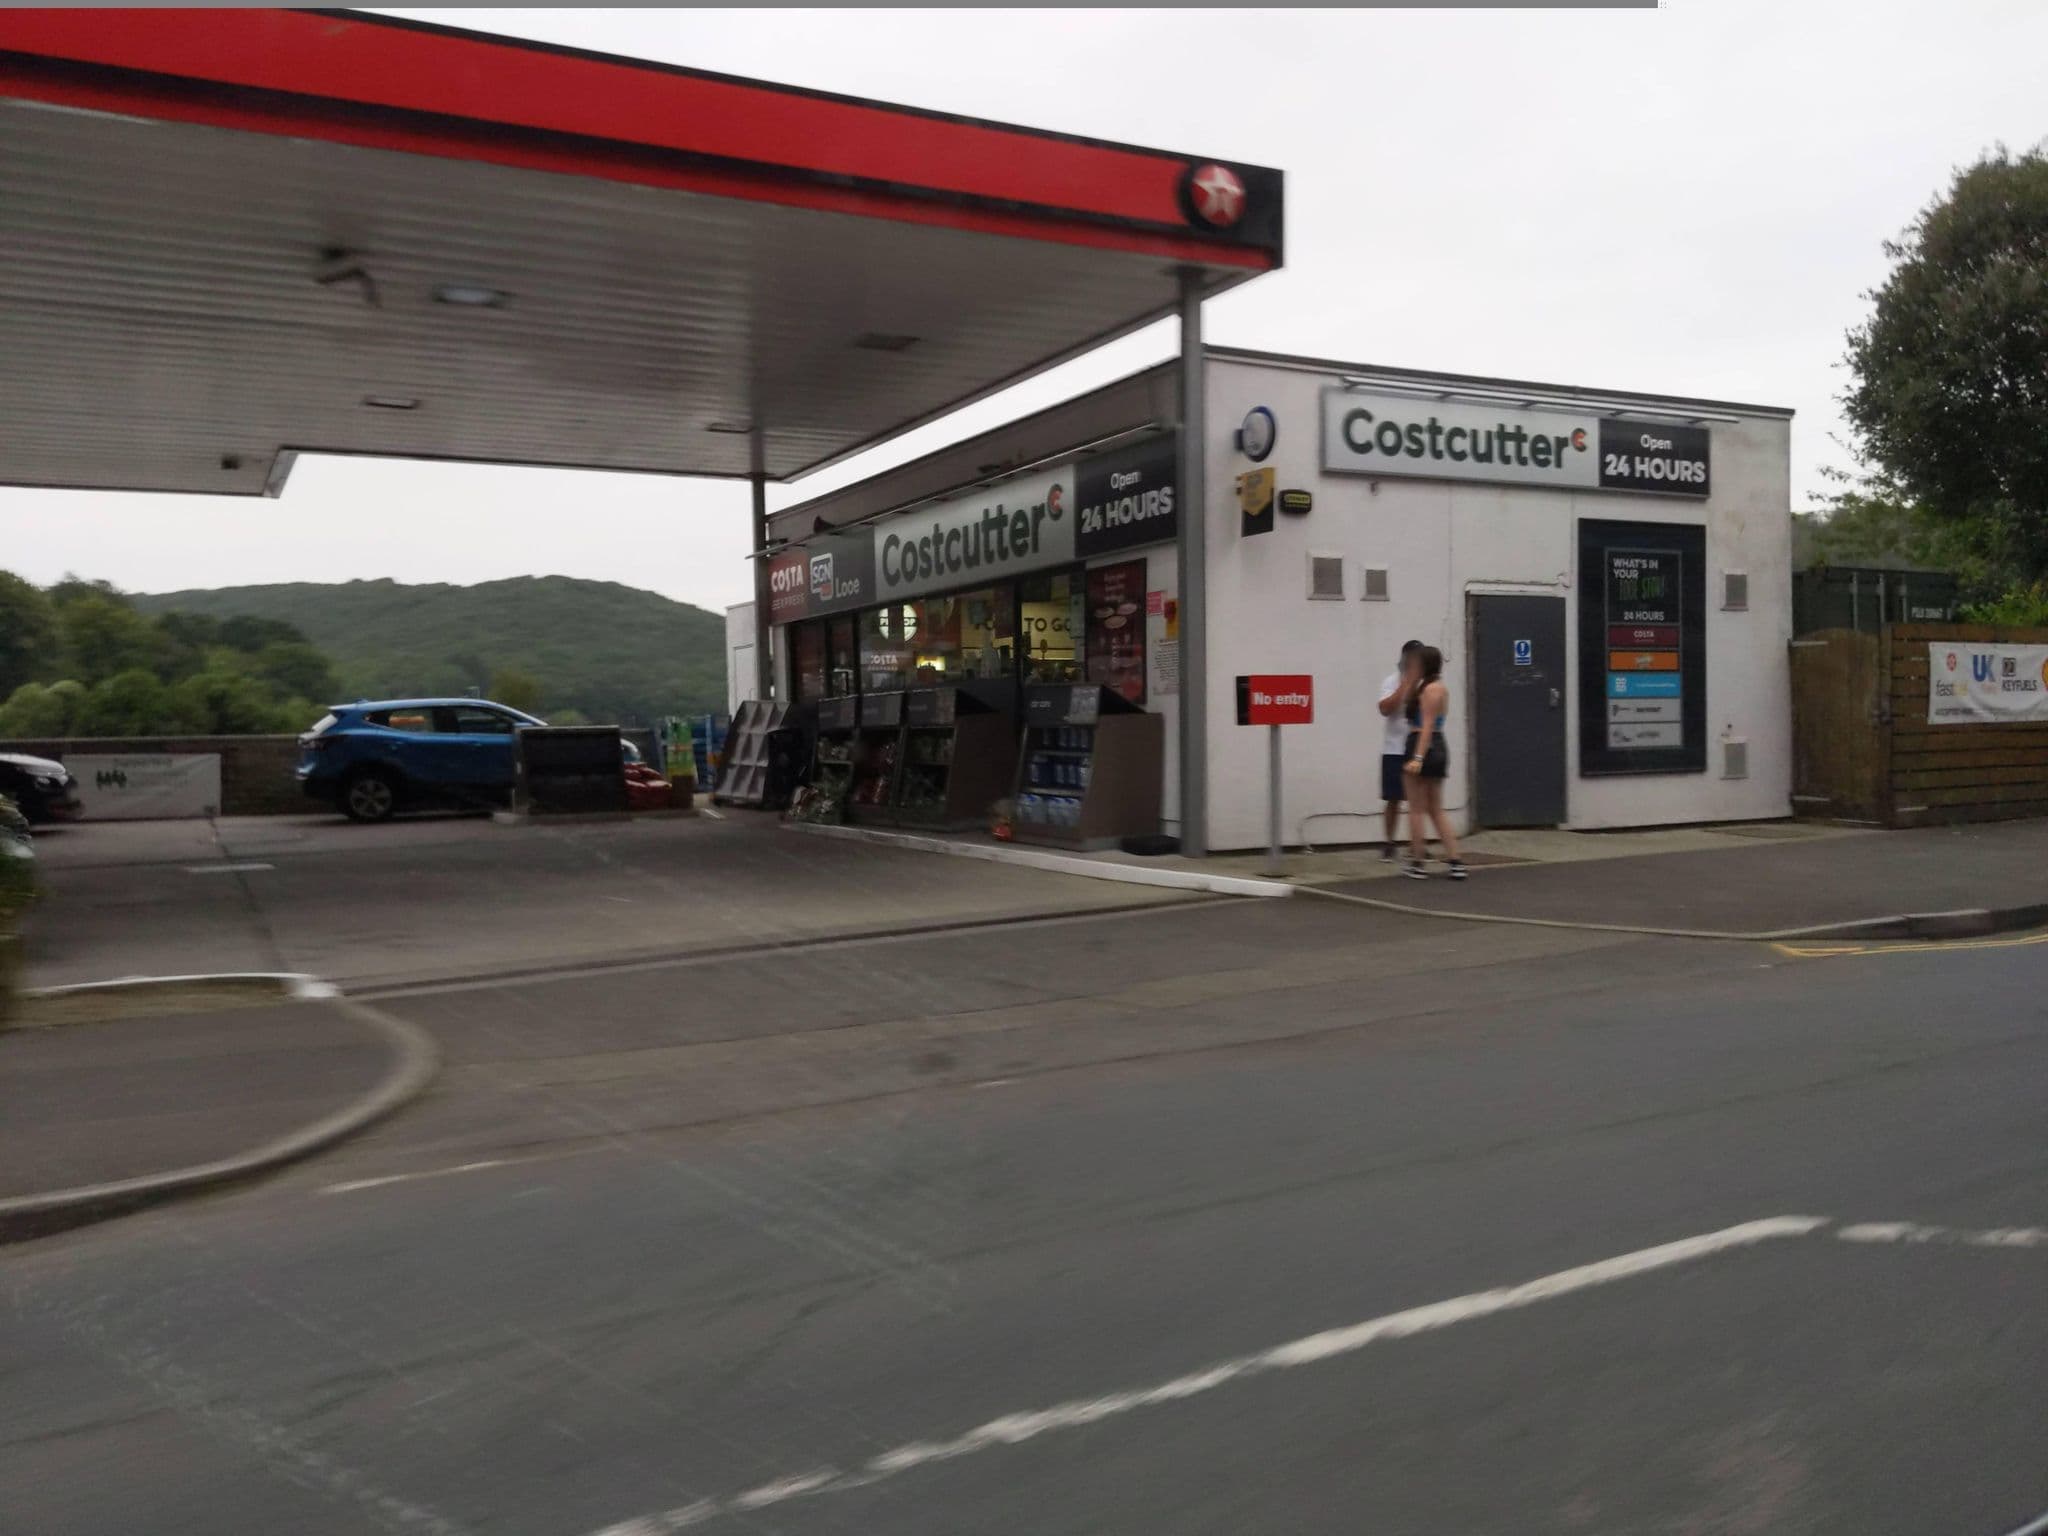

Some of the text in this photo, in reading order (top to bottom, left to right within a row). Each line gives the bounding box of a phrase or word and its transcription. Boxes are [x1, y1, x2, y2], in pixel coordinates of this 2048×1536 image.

[1342, 408, 1569, 468] Costcutter
[1641, 434, 1672, 451] Open
[1605, 454, 1706, 483] 24 HOURS
[1111, 471, 1141, 489] Open
[1081, 486, 1175, 533] 24 HOURS
[882, 502, 1046, 586] Costcutter
[1613, 558, 1659, 569] WHAT'S IN
[771, 564, 804, 592] COSTA
[1613, 569, 1639, 579] YOUR
[1024, 617, 1047, 631] TO
[1623, 611, 1664, 621] 24 HOURS
[1633, 630, 1655, 638] COSTA
[1973, 655, 1996, 682] UK
[2002, 680, 2038, 692] KEYFUELS
[1252, 692, 1310, 708] No entry
